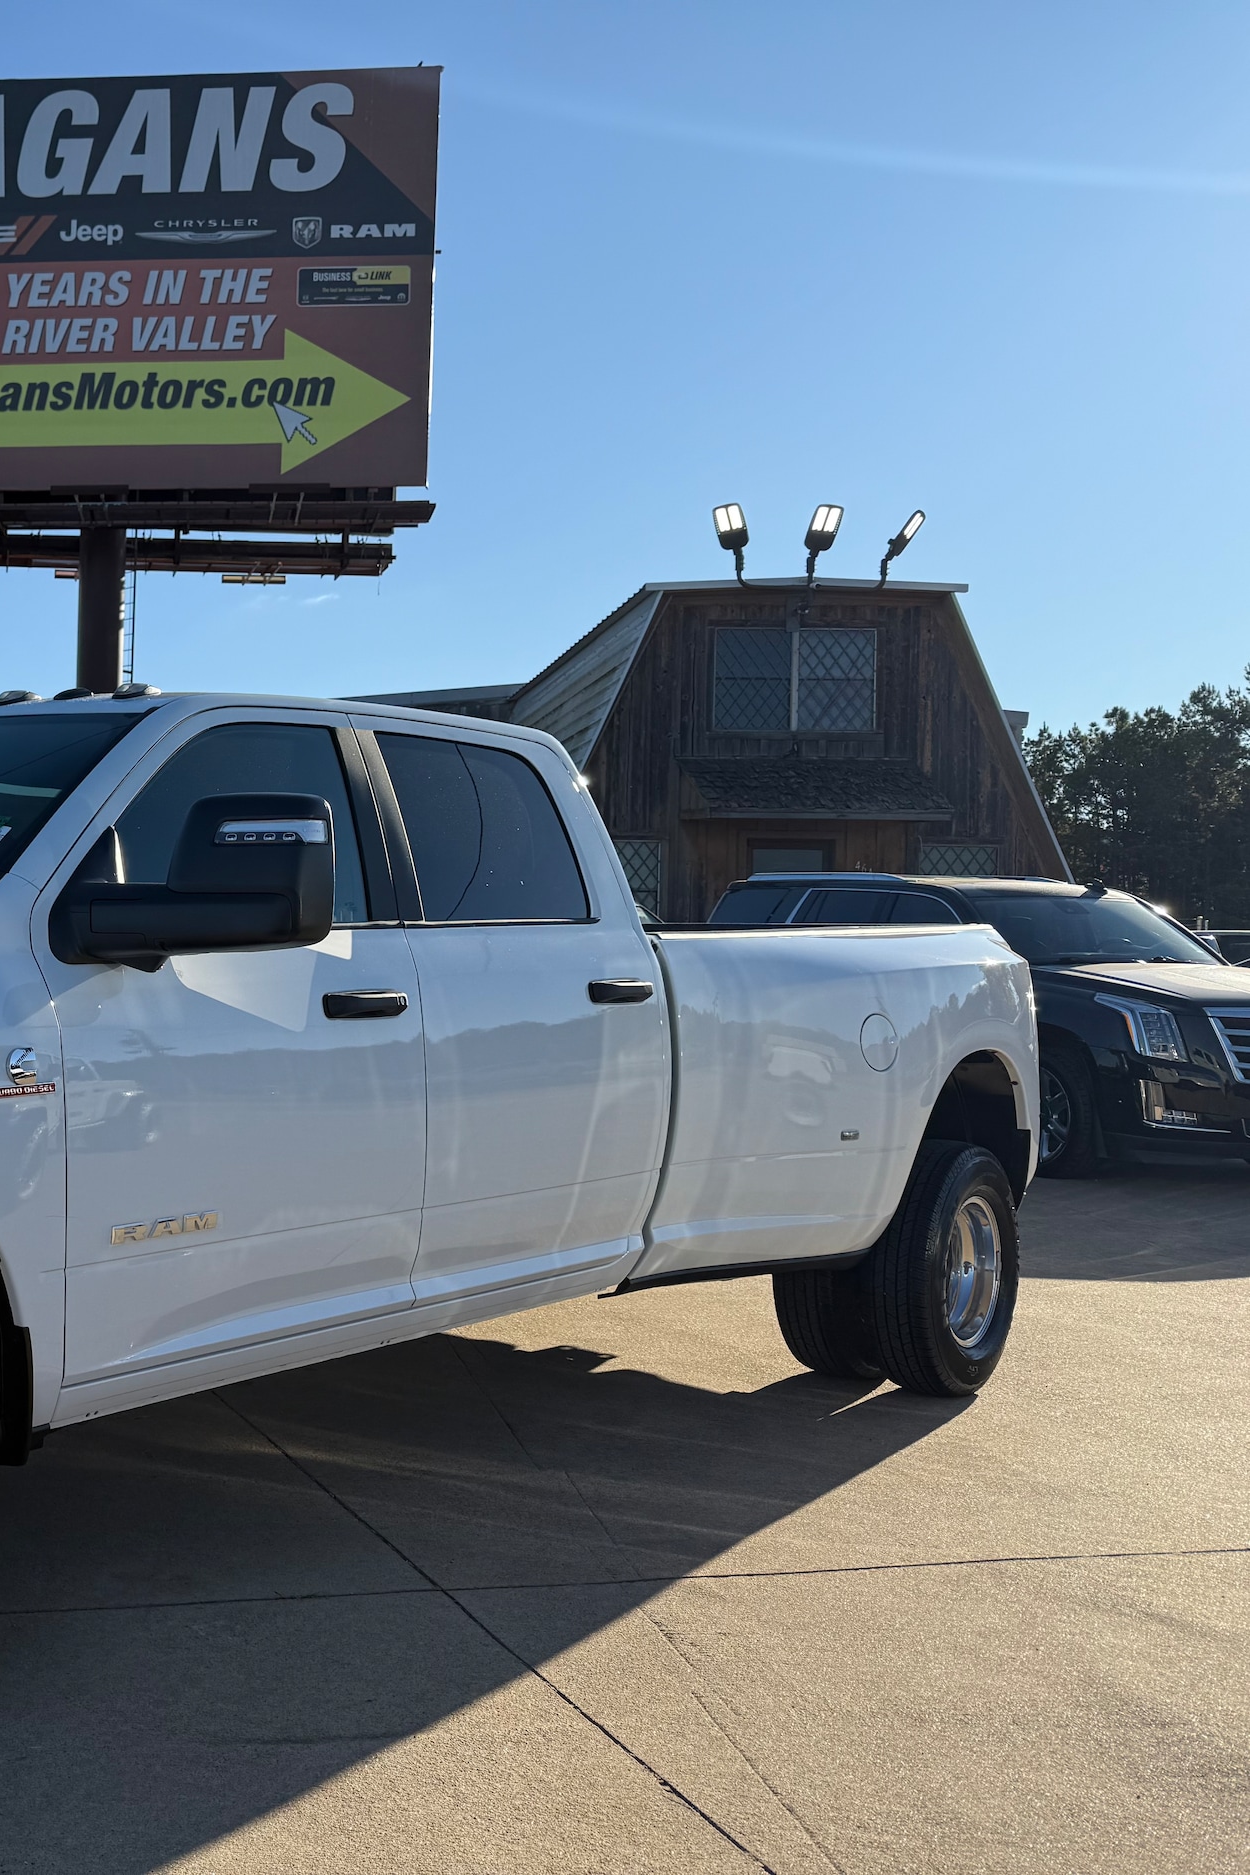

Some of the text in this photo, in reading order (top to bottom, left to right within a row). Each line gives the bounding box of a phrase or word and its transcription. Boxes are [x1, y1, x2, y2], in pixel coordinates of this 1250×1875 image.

[60, 219, 124, 245] Jeep
[153, 218, 259, 228] CHRYSLER
[330, 223, 416, 239] RAM
[313, 271, 392, 282] BUSINESS LINK
[7, 268, 273, 308] YEARS IN THE
[1, 314, 277, 355] RIVER VALLEY
[24, 1084, 55, 1094] DIESEL
[111, 1209, 219, 1246] RAM
